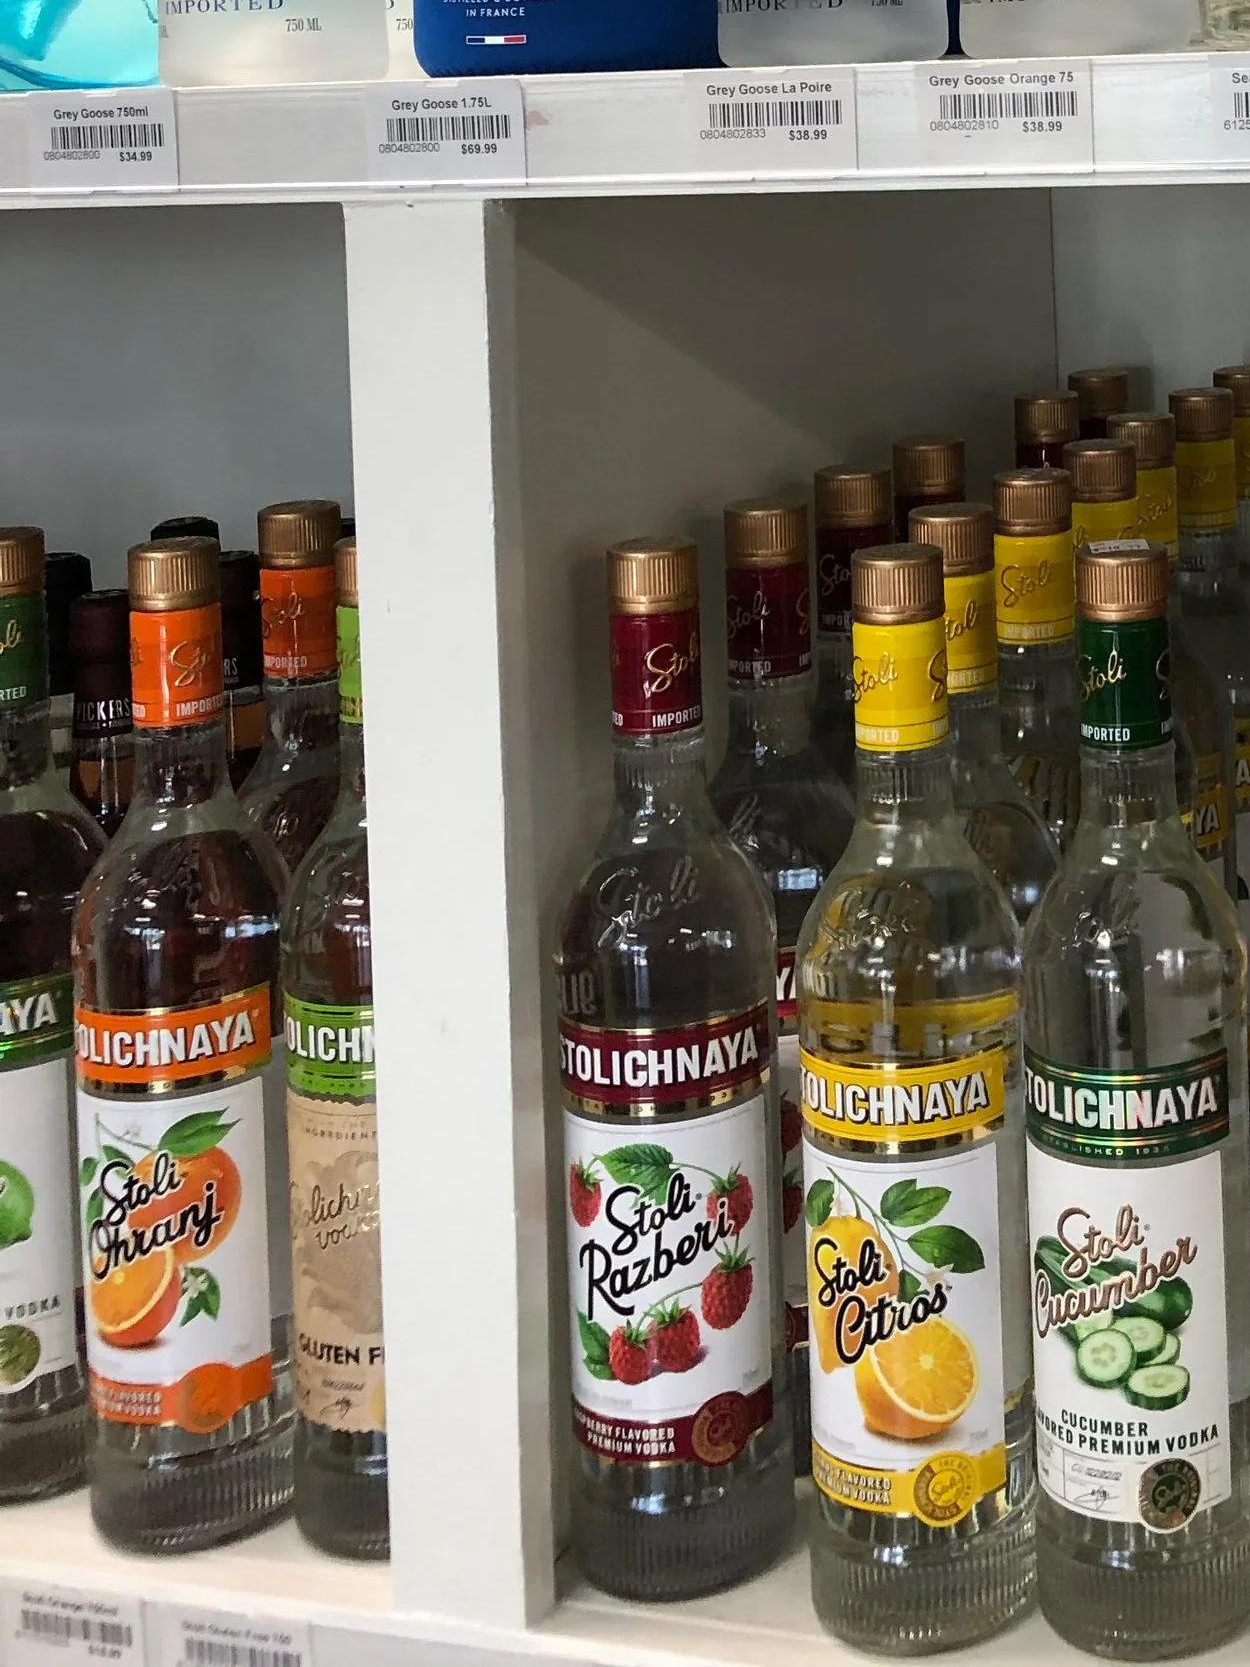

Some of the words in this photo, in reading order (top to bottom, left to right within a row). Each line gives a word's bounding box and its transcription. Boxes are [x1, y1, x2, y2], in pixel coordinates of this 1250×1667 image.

[285, 19, 304, 33] 750
[306, 18, 321, 32] ML
[466, 8, 477, 17] IN
[480, 7, 525, 18] FRANCE
[706, 84, 736, 98] Grey
[738, 83, 779, 96] Goose
[781, 82, 796, 94] La
[800, 81, 832, 94] Poire
[929, 75, 959, 90] Grey
[964, 74, 1005, 86] Goose
[1009, 72, 1055, 87] Orange
[1059, 71, 1074, 84] 75
[53, 108, 78, 121] Grey
[80, 107, 115, 119] Goose
[116, 105, 149, 118] 750ml
[392, 98, 419, 112] Grey
[421, 97, 458, 110] Goose
[461, 97, 492, 109] 1.75L
[788, 128, 828, 142] $38.99
[1022, 120, 1063, 133] $38.99
[119, 150, 152, 163] $34.99
[461, 142, 498, 155] $69.99
[559, 1028, 760, 1088] STOLICHNAYA
[800, 1065, 990, 1127] TOLICHNAYA
[1025, 1066, 1219, 1131] TOLICHNAYA
[100, 1150, 182, 1216] Stoli
[605, 1171, 697, 1256] Stoli
[1057, 1204, 1145, 1279] Stoli
[579, 1198, 733, 1322] Razberi
[814, 1238, 887, 1307] Stoli
[1034, 1235, 1199, 1339] Cucumber
[3, 1294, 62, 1322] VODKA
[835, 1283, 949, 1366] Citros
[615, 1427, 675, 1440] FLAVORED
[1061, 1409, 1148, 1437] CUCUMBER
[635, 1441, 676, 1456] VODKA
[1079, 1433, 1160, 1456] PREMIUM
[1166, 1424, 1219, 1452] VODKA
